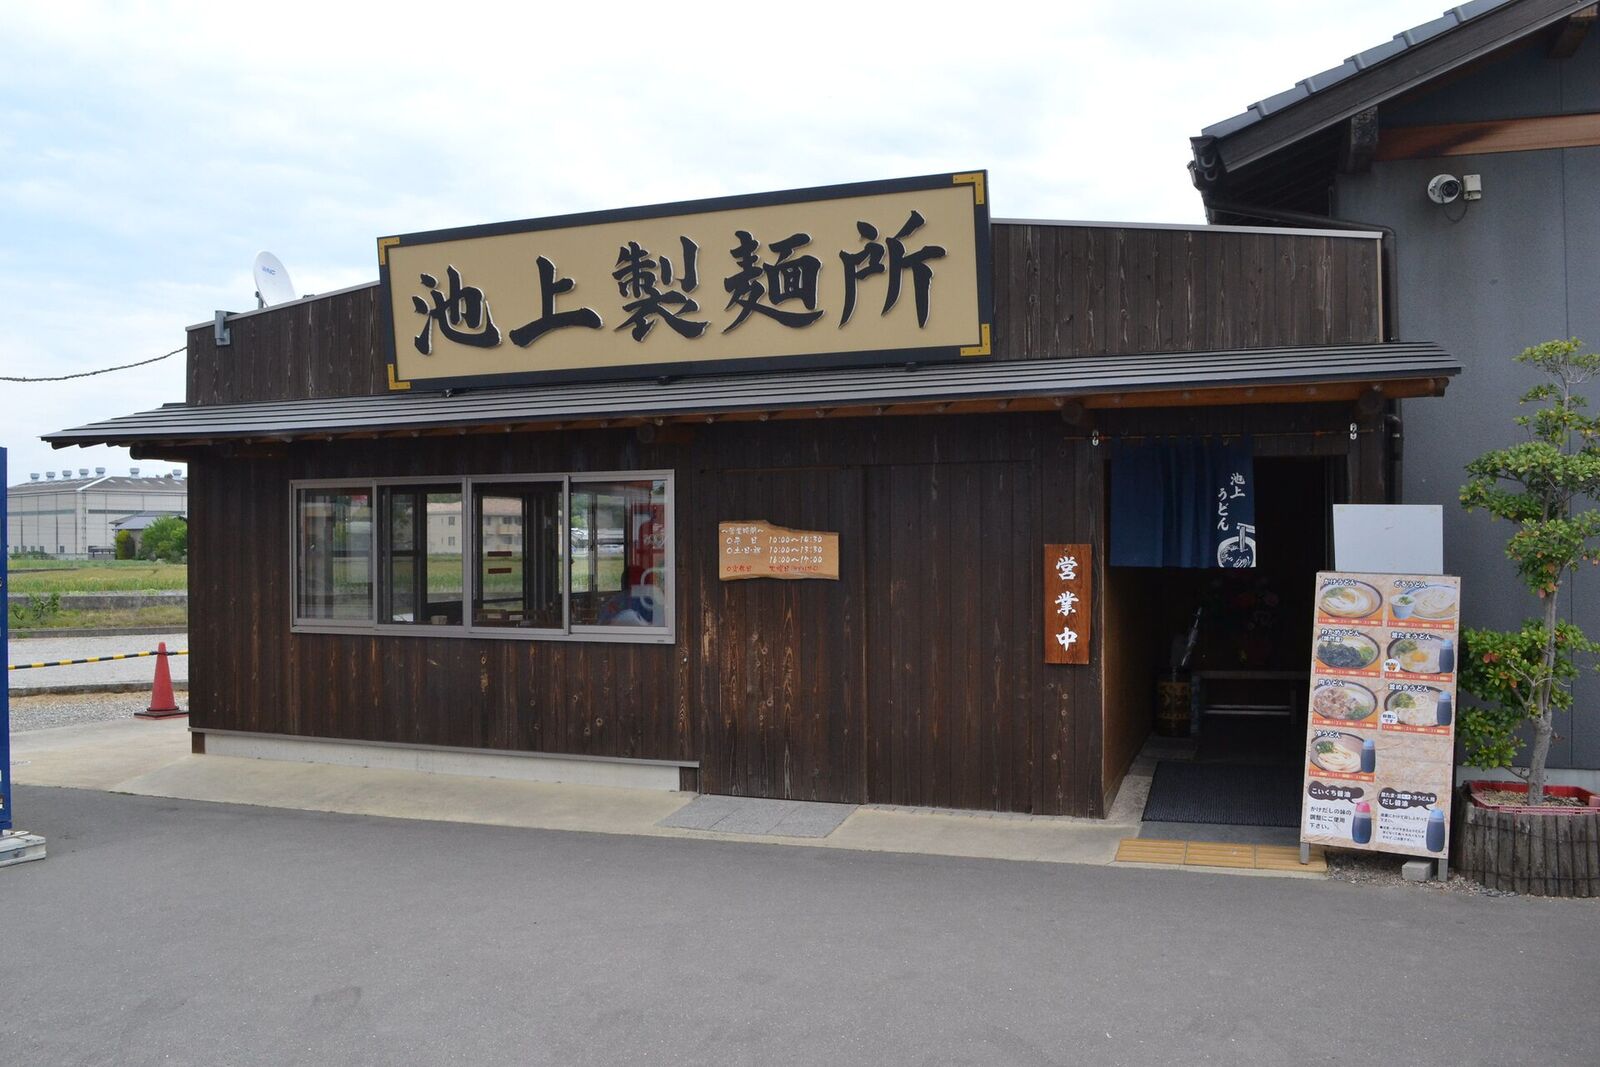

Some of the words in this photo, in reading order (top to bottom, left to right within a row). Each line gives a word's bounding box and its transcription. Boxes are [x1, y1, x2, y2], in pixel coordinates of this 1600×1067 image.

[413, 210, 948, 355] 池上製麺所
[1230, 472, 1246, 499] 池上
[1217, 487, 1229, 531] うどん
[1055, 556, 1079, 651] 営業中
[1311, 787, 1352, 798] こいくち醤油
